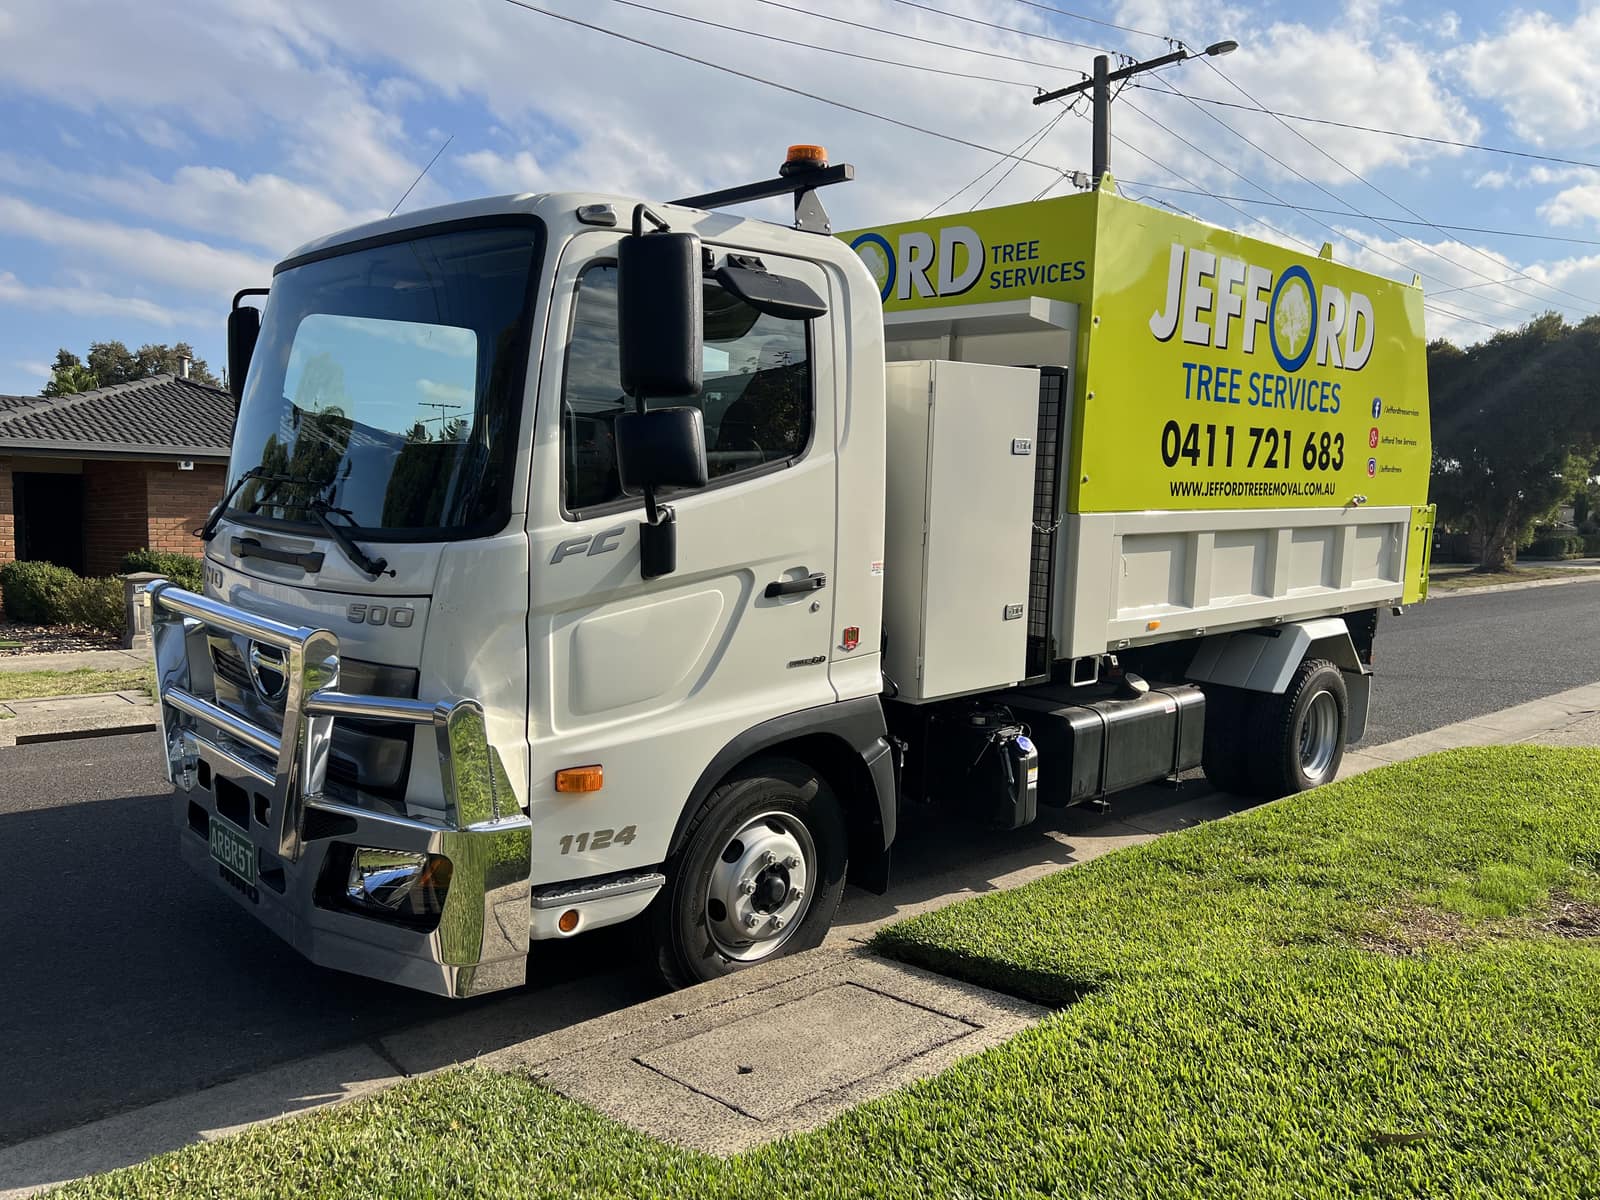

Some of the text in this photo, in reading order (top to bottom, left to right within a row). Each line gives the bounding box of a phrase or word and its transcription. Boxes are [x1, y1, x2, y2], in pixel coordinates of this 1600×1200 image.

[849, 226, 986, 304] ORD
[991, 240, 1040, 264] TREE
[989, 260, 1086, 290] SERVICES
[1149, 242, 1375, 373] JEFFORD
[1182, 362, 1342, 415] TREE SERVICES
[1161, 419, 1345, 471] 0411 721 683
[1169, 480, 1336, 497] WWW.JEFFORDTREEREMOVAL.COM.AU
[549, 526, 626, 566] FC
[347, 602, 415, 629] 500
[559, 824, 638, 855] 1124
